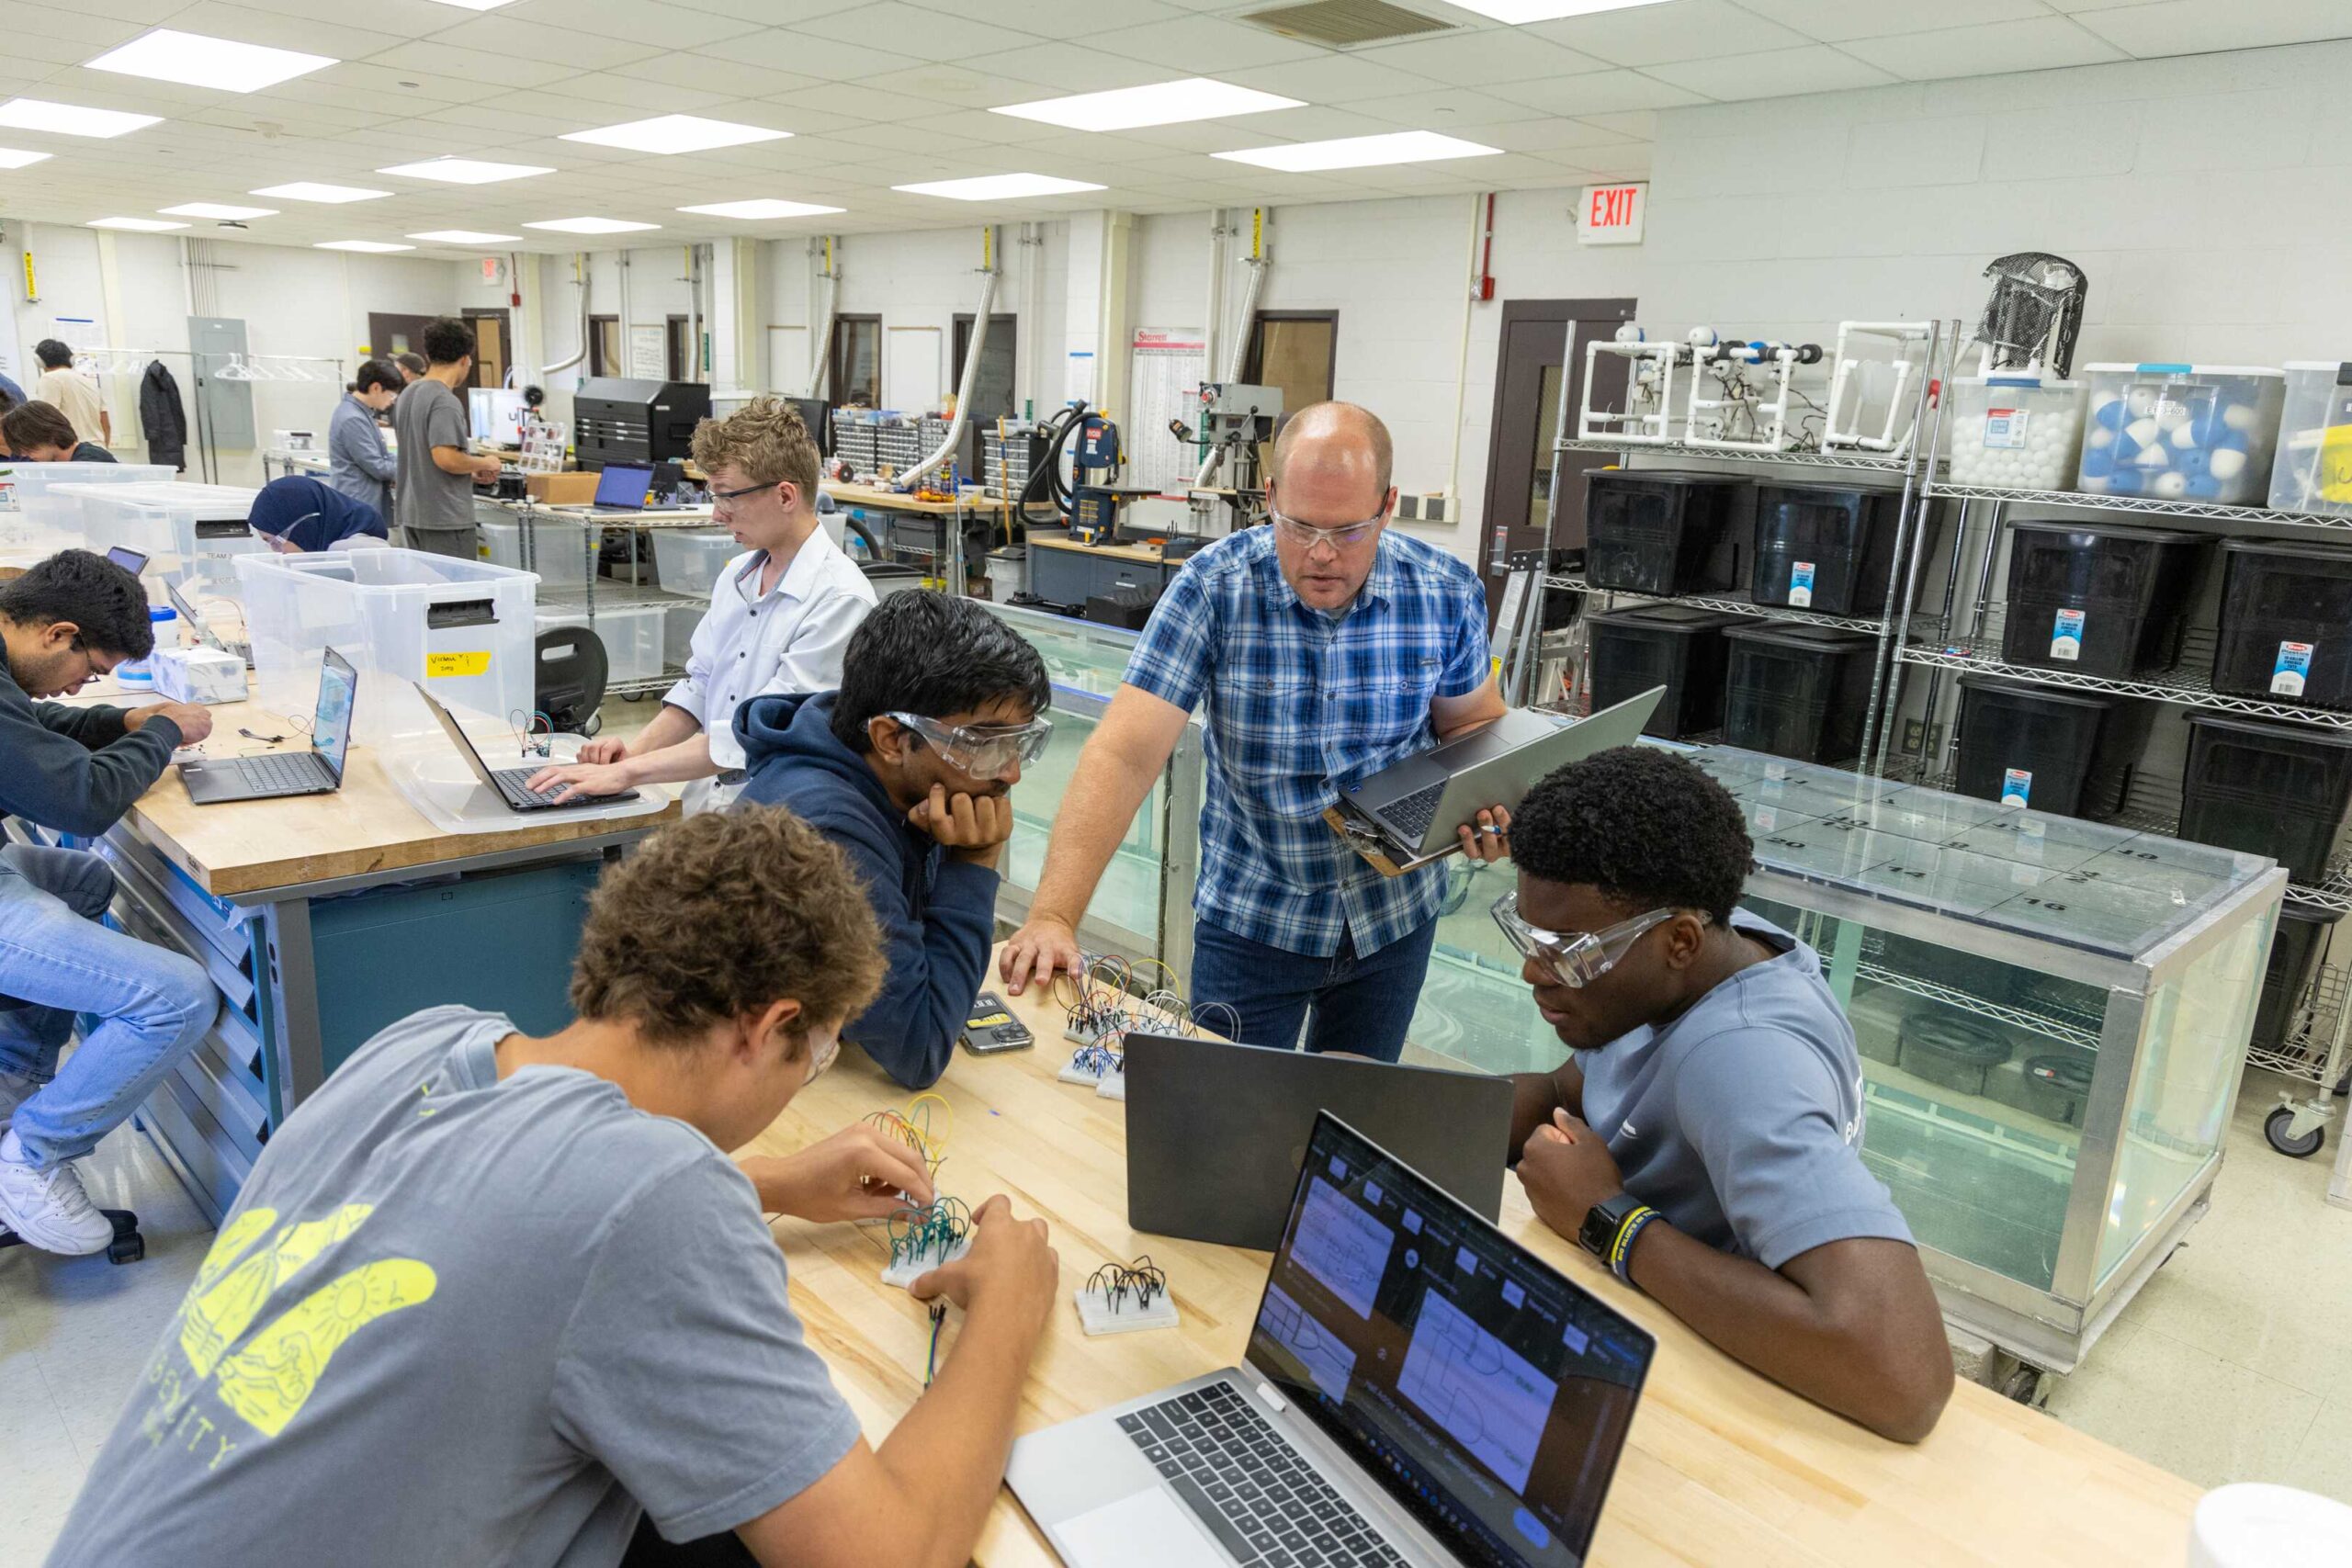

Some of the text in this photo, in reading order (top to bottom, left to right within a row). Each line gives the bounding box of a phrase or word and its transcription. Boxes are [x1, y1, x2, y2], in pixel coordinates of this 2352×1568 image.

[1590, 187, 1637, 227] EXIT
[1765, 836, 1805, 849] 20
[2024, 897, 2068, 911] 16
[1617, 1247, 1625, 1262] BIG
